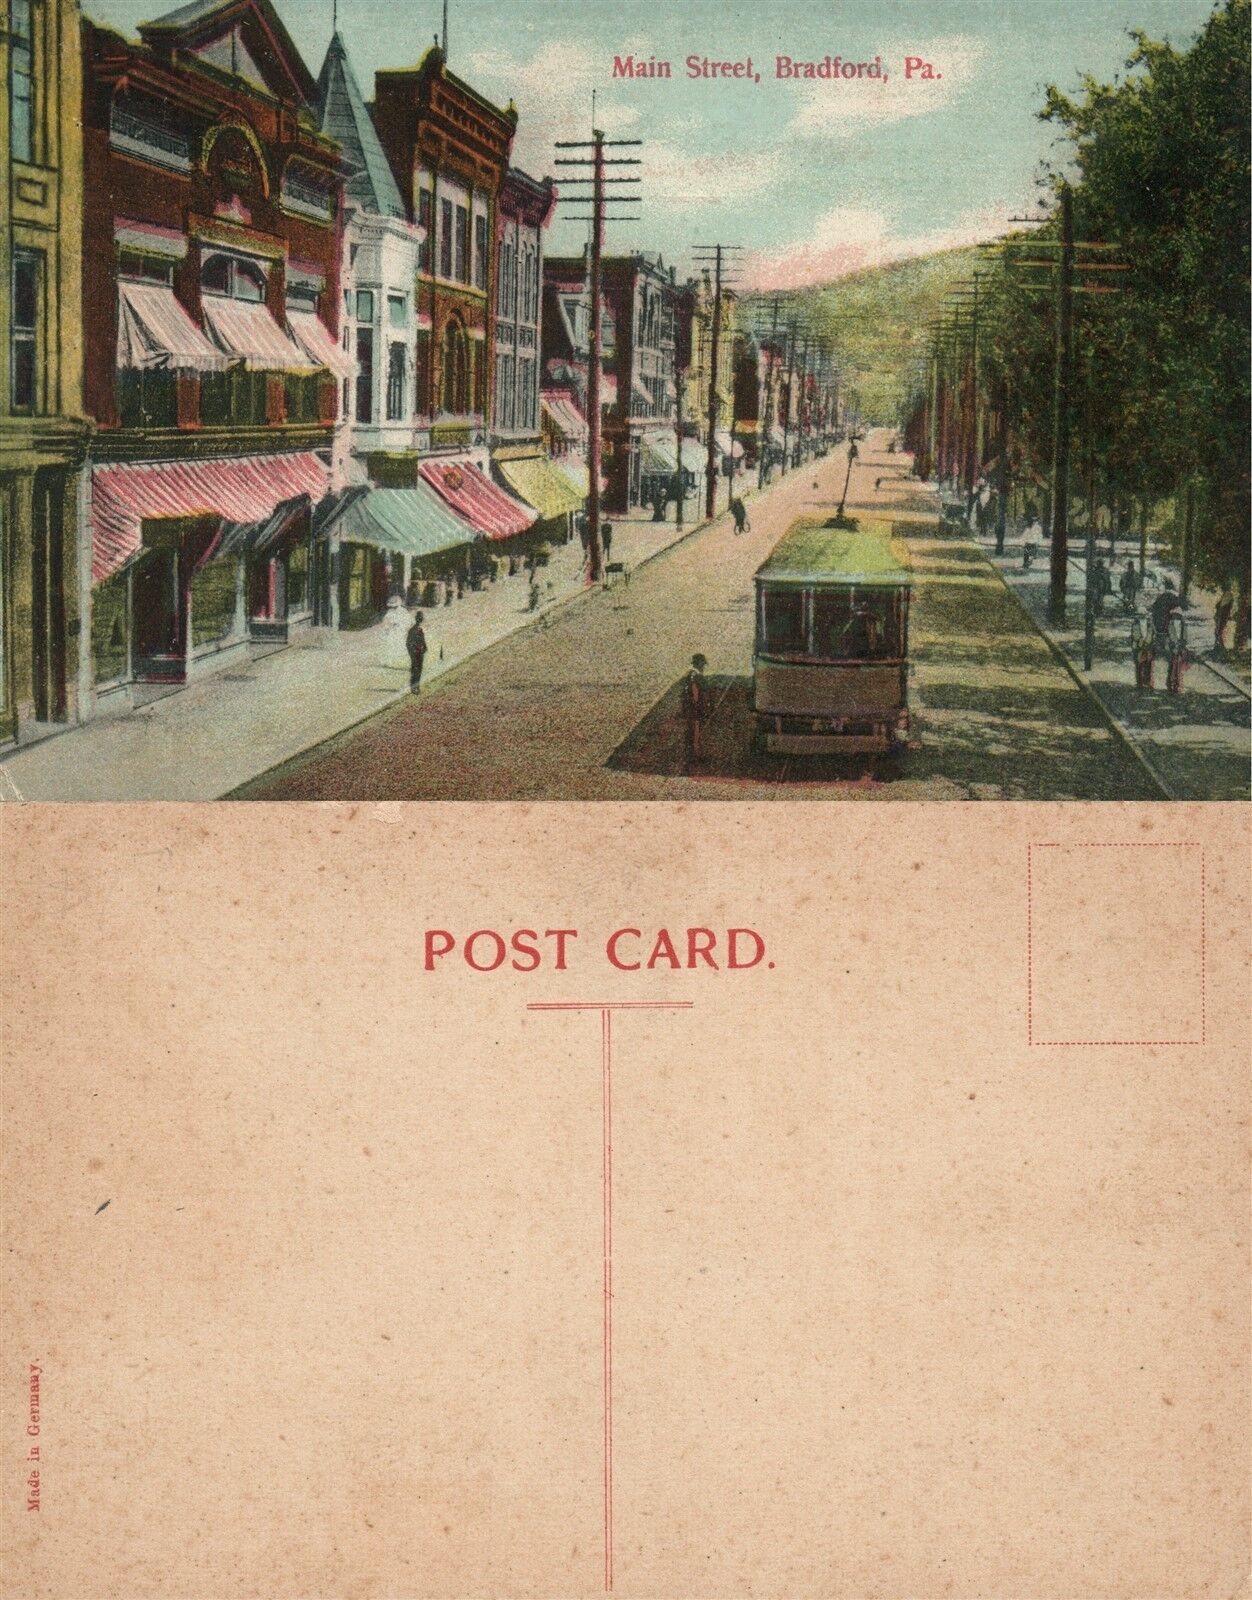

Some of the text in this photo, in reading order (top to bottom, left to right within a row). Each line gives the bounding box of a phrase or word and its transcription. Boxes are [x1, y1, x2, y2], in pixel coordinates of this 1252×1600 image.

[424, 928, 776, 971] POST CARD.
[27, 1447, 40, 1462] in
[27, 1470, 40, 1512] Made
